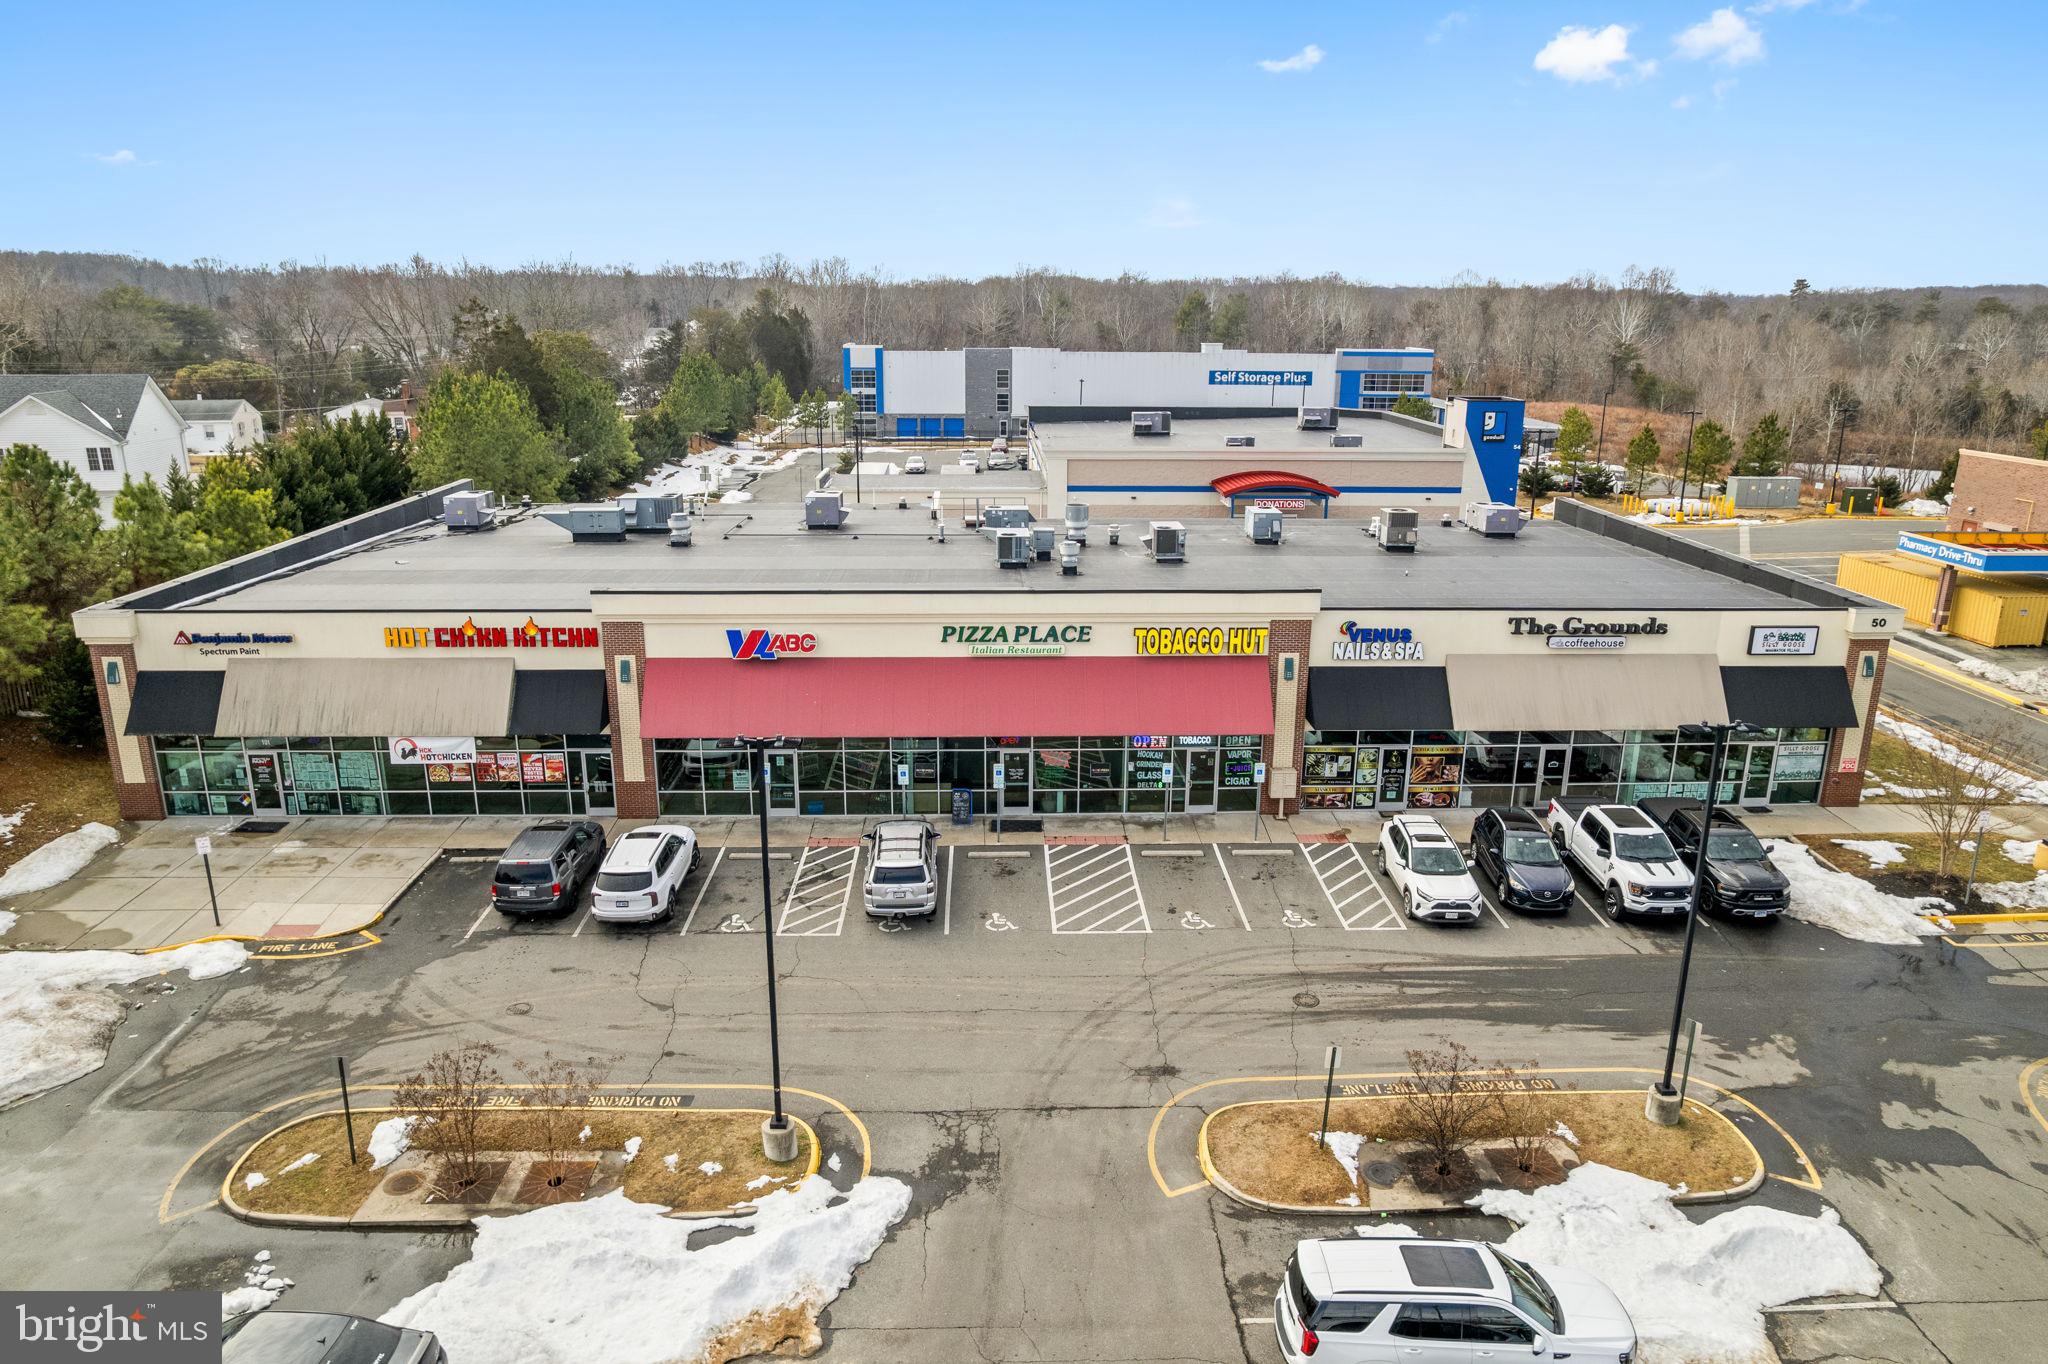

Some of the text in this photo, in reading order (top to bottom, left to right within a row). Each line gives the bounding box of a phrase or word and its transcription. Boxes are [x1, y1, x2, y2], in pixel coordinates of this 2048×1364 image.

[1215, 372, 1307, 385] Self Storage Plus
[1900, 536, 1982, 566] Pharmacy Drive-Thru
[1508, 617, 1668, 635] The Grounds
[1872, 619, 1886, 627] 50
[384, 628, 430, 648] HOT
[941, 626, 1092, 642] PIZZA PLACE
[1347, 628, 1413, 643] VENUS
[777, 634, 817, 652] ABC
[1134, 628, 1268, 655] TOBACCO HUT
[1564, 639, 1624, 648] coffeehouse
[200, 648, 238, 656] Spectrum
[971, 646, 1062, 654] Italian Restaurant
[1333, 642, 1424, 660] NAILS & SPA
[1133, 735, 1167, 748] OPEN
[1179, 736, 1211, 744] TOBACCO
[1226, 736, 1251, 744] OPEN
[1137, 750, 1164, 759] HOOKAH
[259, 942, 339, 953] FIRE LANE
[1340, 1085, 1381, 1095] LANE
[483, 1096, 524, 1106] FIRE
[659, 1096, 681, 1106] NO
